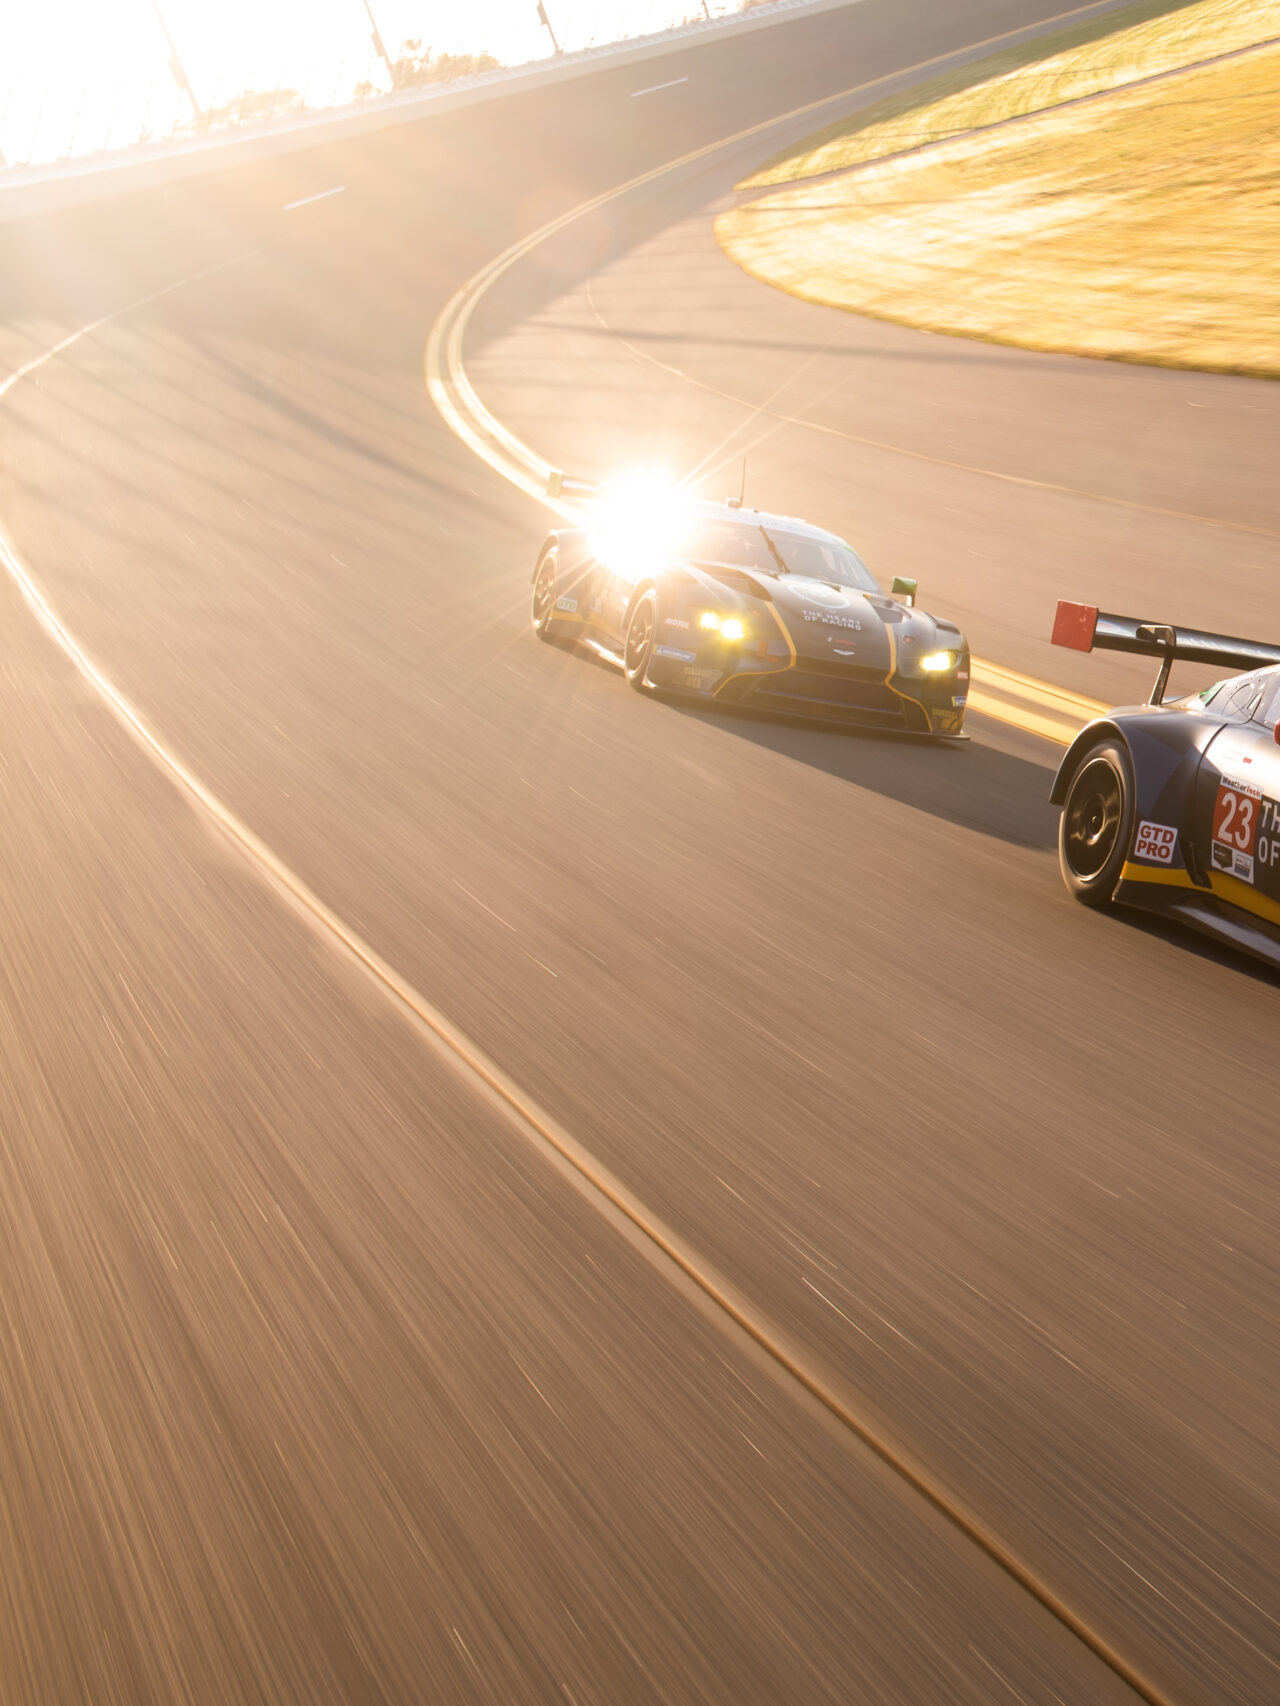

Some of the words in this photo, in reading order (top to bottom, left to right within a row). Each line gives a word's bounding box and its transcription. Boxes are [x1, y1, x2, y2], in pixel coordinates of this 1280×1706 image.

[1222, 776, 1261, 798] WeatherTech
[1217, 792, 1254, 849] 23
[1140, 825, 1175, 844] GTD
[1137, 841, 1171, 859] PRO
[1258, 836, 1280, 867] OF
